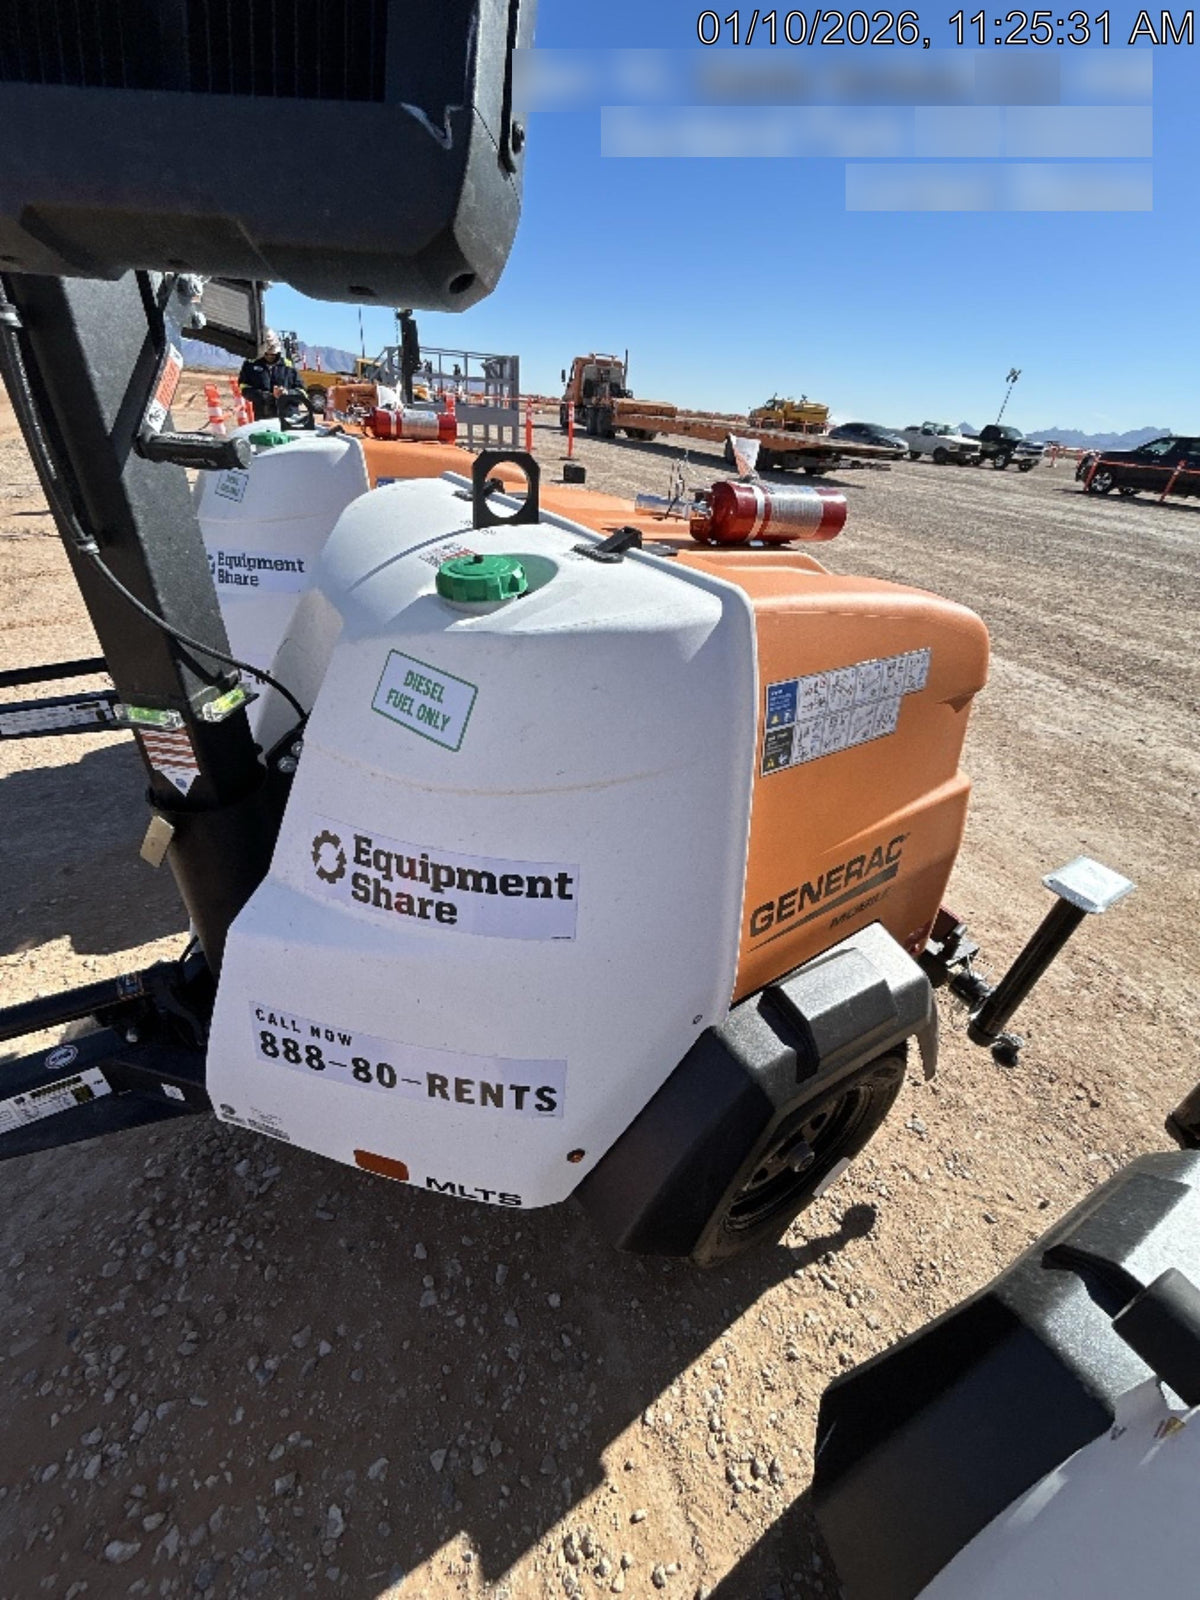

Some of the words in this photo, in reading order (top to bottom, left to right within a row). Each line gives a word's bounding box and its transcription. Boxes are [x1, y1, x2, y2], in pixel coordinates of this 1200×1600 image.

[217, 551, 305, 573] Equipment
[403, 669, 446, 704] DIESEL
[385, 688, 415, 717] FUEL
[416, 703, 451, 732] ONLY
[353, 834, 574, 900] Equipment
[749, 832, 905, 938] GENERAC
[351, 871, 458, 925] Share
[255, 1008, 301, 1033] CALL
[310, 1025, 352, 1047] NOW
[425, 1176, 522, 1206] MLTS
